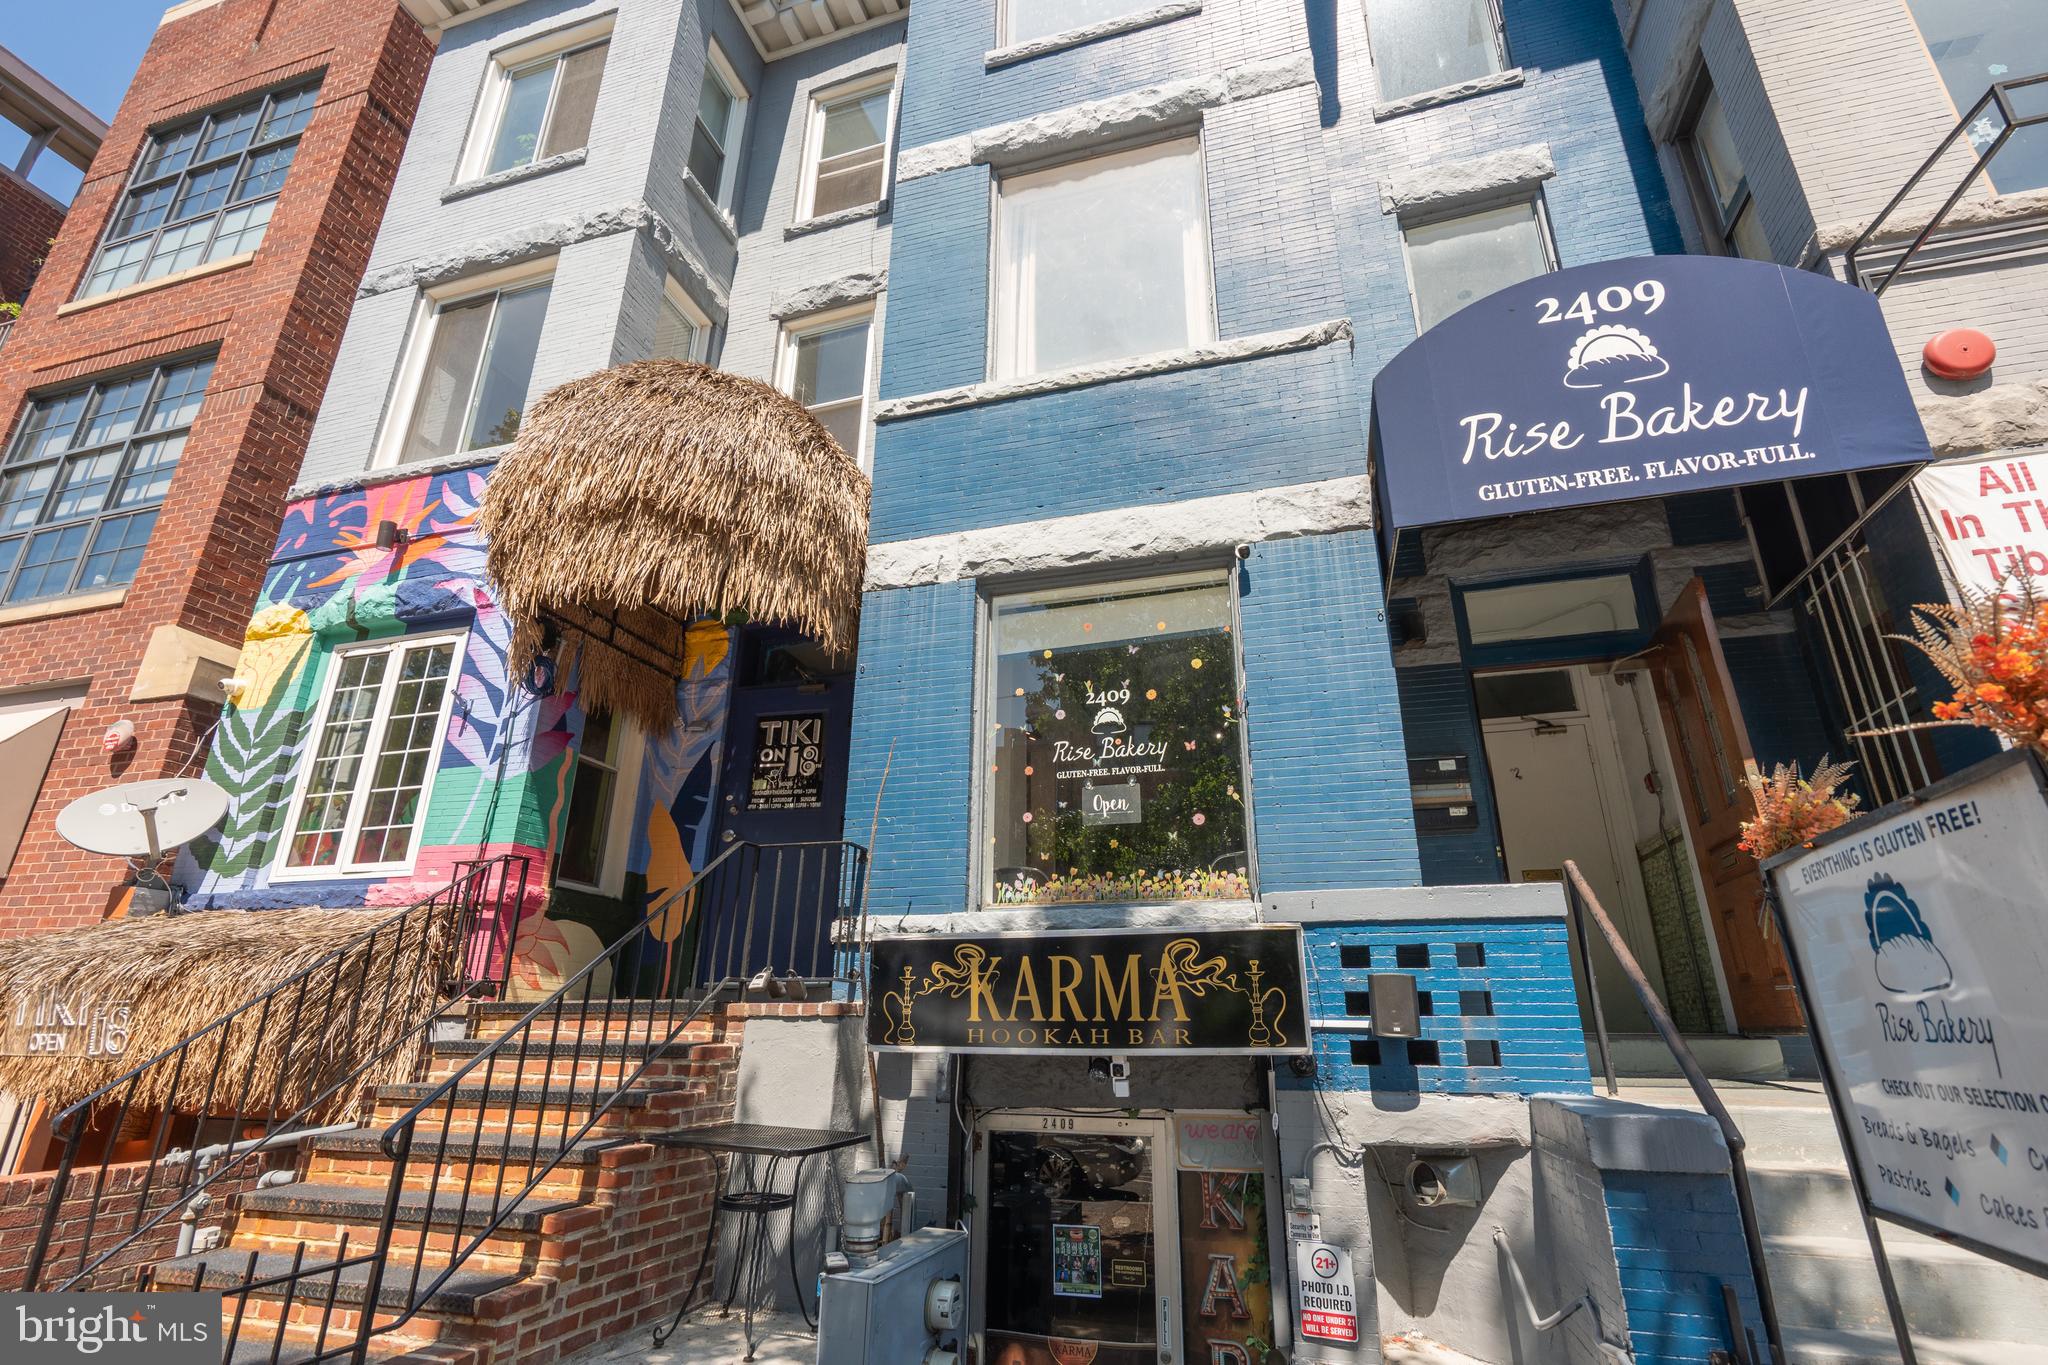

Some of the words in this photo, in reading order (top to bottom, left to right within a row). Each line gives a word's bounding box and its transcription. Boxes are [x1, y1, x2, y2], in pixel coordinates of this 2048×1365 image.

[1534, 280, 1665, 324] 2409
[1459, 412, 1585, 464] Rise
[1598, 382, 1808, 443] Bakery
[1478, 466, 1639, 501] GLUTEN-FREE.
[1643, 443, 1816, 480] FLAVOR-FULL.
[1980, 462, 2037, 496] All
[1940, 509, 1986, 540] In
[1086, 689, 1130, 706] 2409
[760, 719, 821, 746] TIKI
[760, 747, 786, 762] ON
[788, 745, 819, 776] 18
[1053, 740, 1095, 763] Rise
[1099, 736, 1168, 762] Bakery
[1056, 768, 1111, 779] GLUTEN-FREE.
[1112, 764, 1165, 775] FLAVOR-FULL.
[1093, 795, 1130, 817] Open
[1801, 847, 1860, 885] EVERYTHING
[1860, 842, 1873, 863] IS
[1873, 820, 1926, 857] GLUTEN
[1926, 801, 1982, 839] FREE!
[967, 953, 1191, 1022] KARMA
[29, 1033, 67, 1051] OPEN
[967, 1028, 1109, 1045] HOOKAH
[1129, 1028, 1192, 1045] BAR
[1875, 1002, 1920, 1042] Rise
[1916, 1000, 2002, 1079] Bakery
[1881, 1078, 1911, 1096] CHECK
[1914, 1081, 1934, 1099] OUT
[1938, 1085, 1961, 1104] OUR
[1965, 1087, 2039, 1113] SELECTION
[1043, 1118, 1074, 1130] 2409
[1185, 1123, 1219, 1139] we
[1221, 1121, 1258, 1140] are
[1861, 1116, 1904, 1142] Breads
[1906, 1122, 1918, 1145] &
[1919, 1127, 1976, 1160] Bagels
[1878, 1164, 1931, 1197] Pastries
[1980, 1193, 2039, 1229] Cakes
[1290, 1222, 1307, 1231] Security
[1315, 1257, 1336, 1269] 21+
[1301, 1280, 1333, 1294] PHOTO
[1336, 1284, 1352, 1297] I.D.
[1304, 1295, 1352, 1312] REQUIRED
[1302, 1313, 1311, 1322] NO
[1312, 1314, 1325, 1323] ONE
[1325, 1315, 1347, 1326] UNDER
[1347, 1318, 1355, 1327] 21
[1306, 1323, 1320, 1333] WILL
[1320, 1325, 1330, 1334] BE
[1330, 1326, 1354, 1337] SERVED
